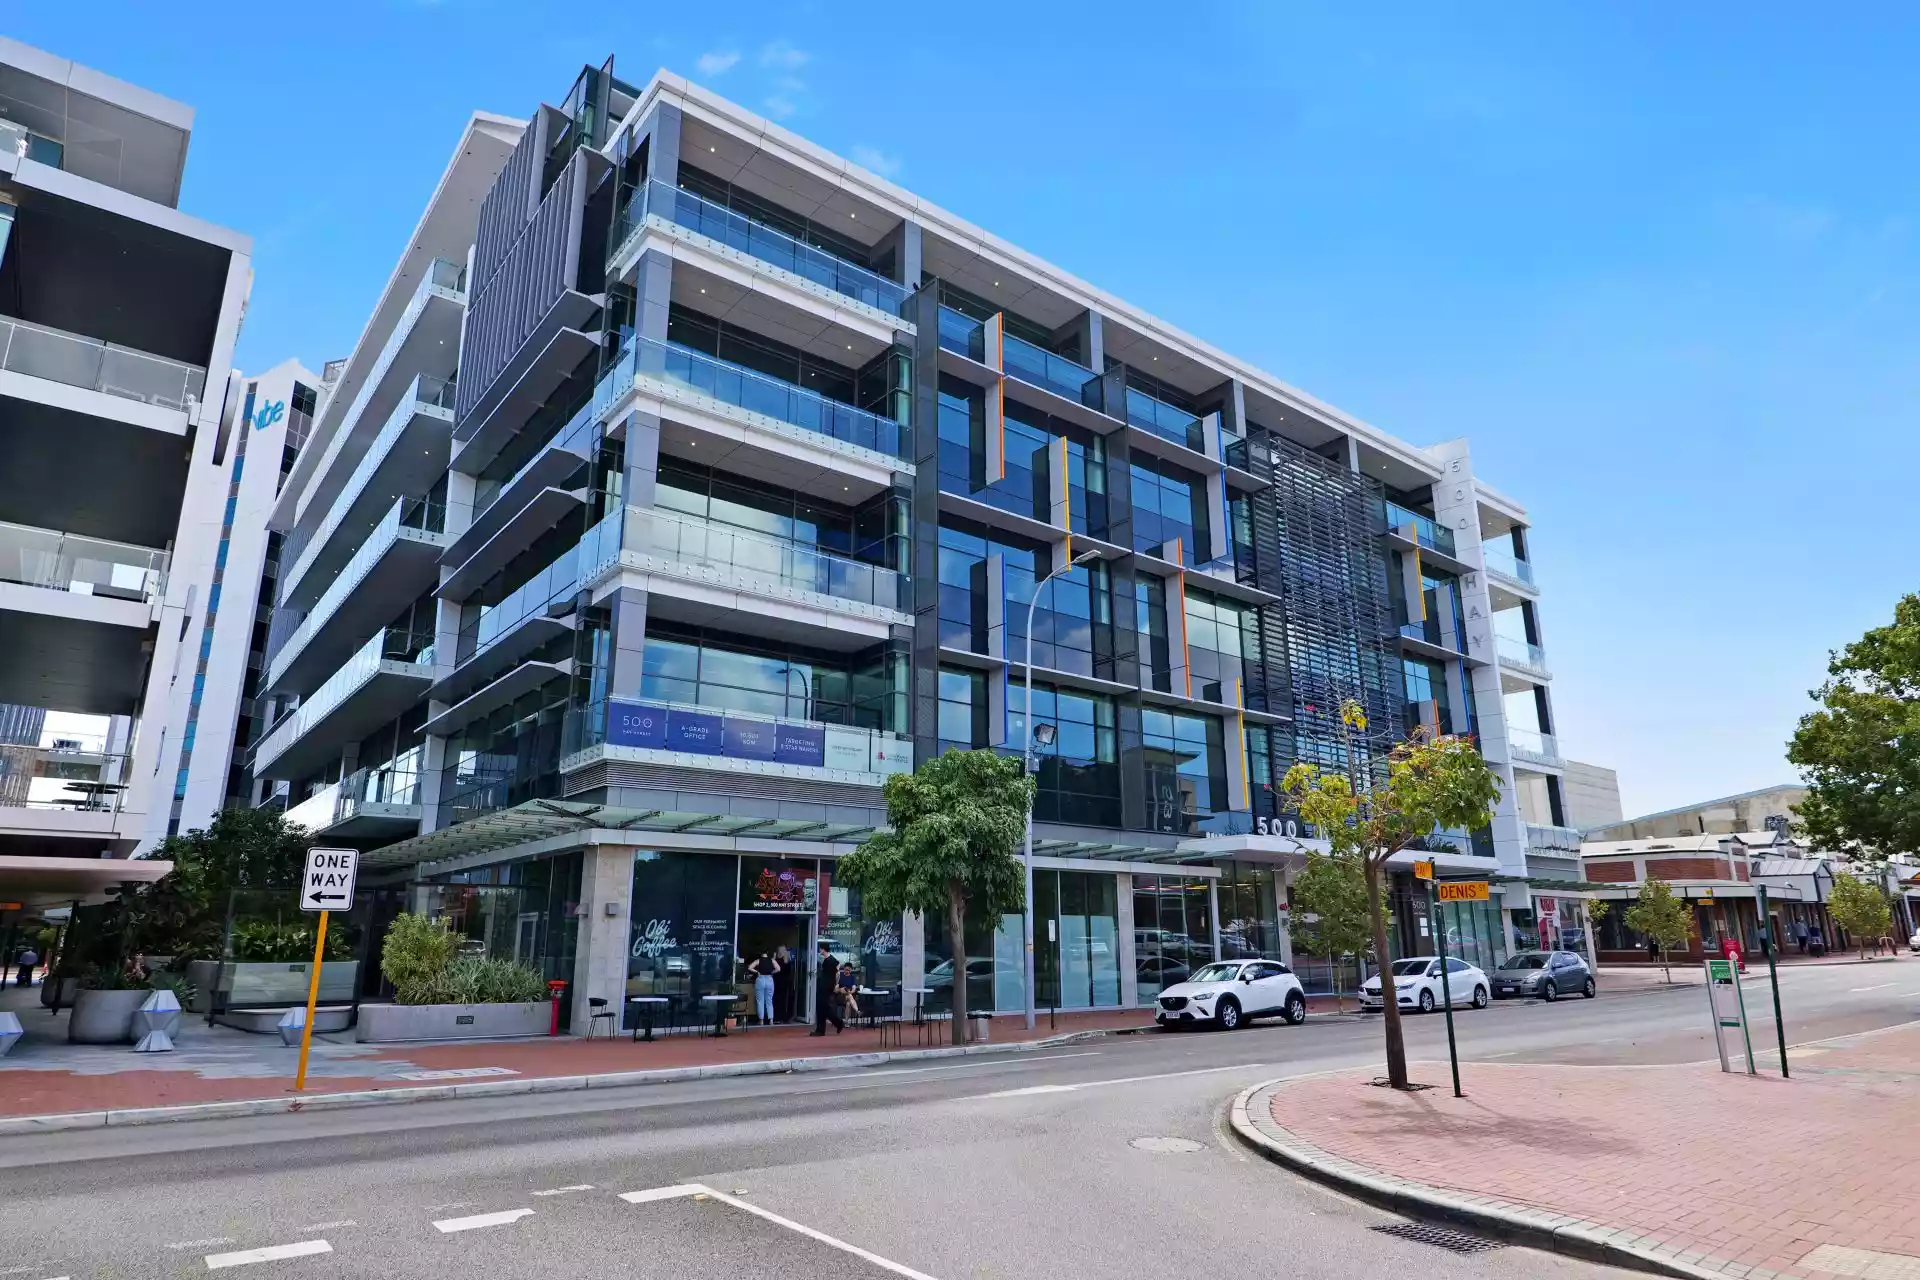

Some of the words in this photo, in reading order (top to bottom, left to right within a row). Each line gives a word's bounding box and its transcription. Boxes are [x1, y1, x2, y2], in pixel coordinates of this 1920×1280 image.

[1464, 574, 1484, 648] HAY
[623, 715, 653, 728] 500
[681, 725, 710, 734] A-GRADE
[684, 732, 706, 740] OFFICE
[1257, 816, 1297, 838] 500
[314, 854, 350, 868] ONE
[311, 872, 348, 887] WAY
[1440, 884, 1476, 899] DENIS
[645, 919, 672, 939] Obi
[874, 921, 893, 938] Obi
[632, 936, 677, 957] Coffee
[864, 936, 899, 955] Coffee
